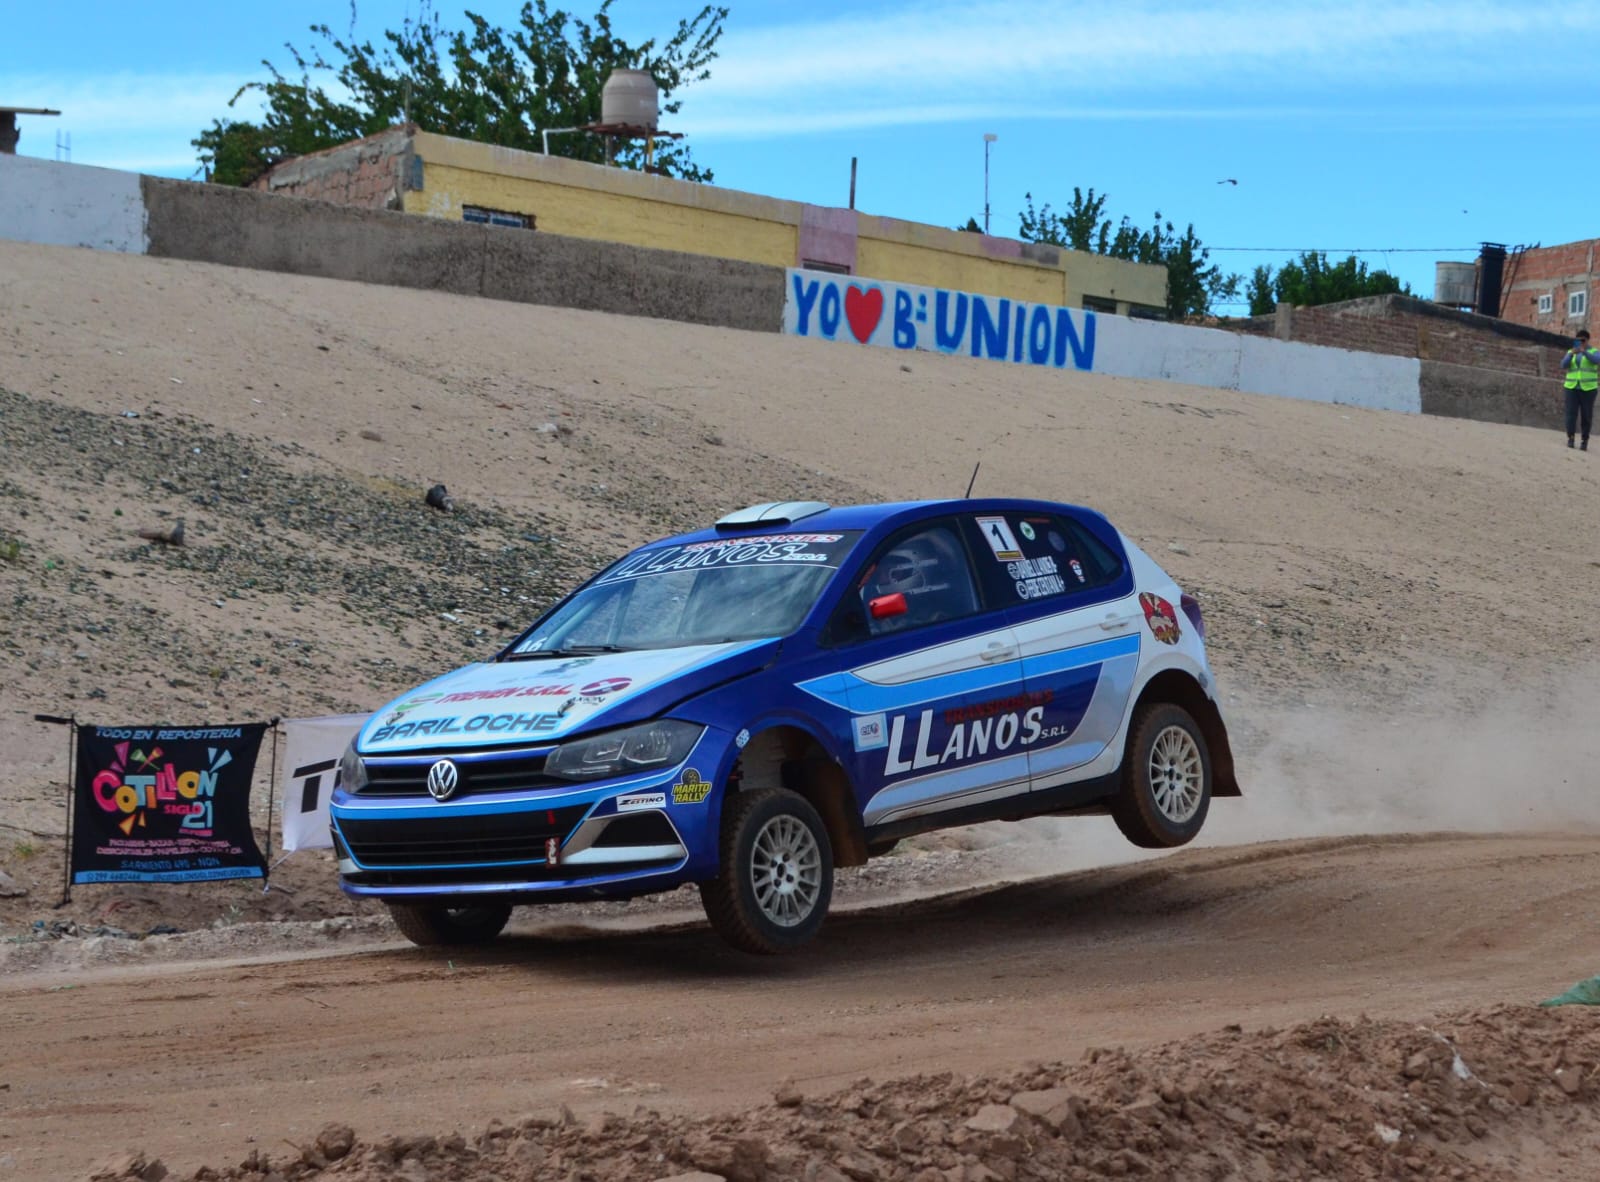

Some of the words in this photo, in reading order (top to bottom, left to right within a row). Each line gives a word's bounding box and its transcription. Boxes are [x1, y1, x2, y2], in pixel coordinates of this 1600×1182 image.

[793, 273, 841, 340] YO
[934, 289, 1097, 371] UNION
[991, 523, 1009, 550] 1
[596, 543, 809, 584] LLANOS
[96, 727, 131, 738] TODO
[133, 729, 153, 740] EN
[156, 728, 242, 740] REPOSTERIA
[369, 713, 562, 743] BARILOCHE
[884, 706, 1044, 776] LLANOS
[92, 763, 219, 814] COTILLON
[292, 758, 344, 813] T
[674, 783, 711, 795] MARITO
[674, 793, 706, 803] RALLY
[164, 803, 202, 815] SIGLO
[181, 801, 213, 828] 21
